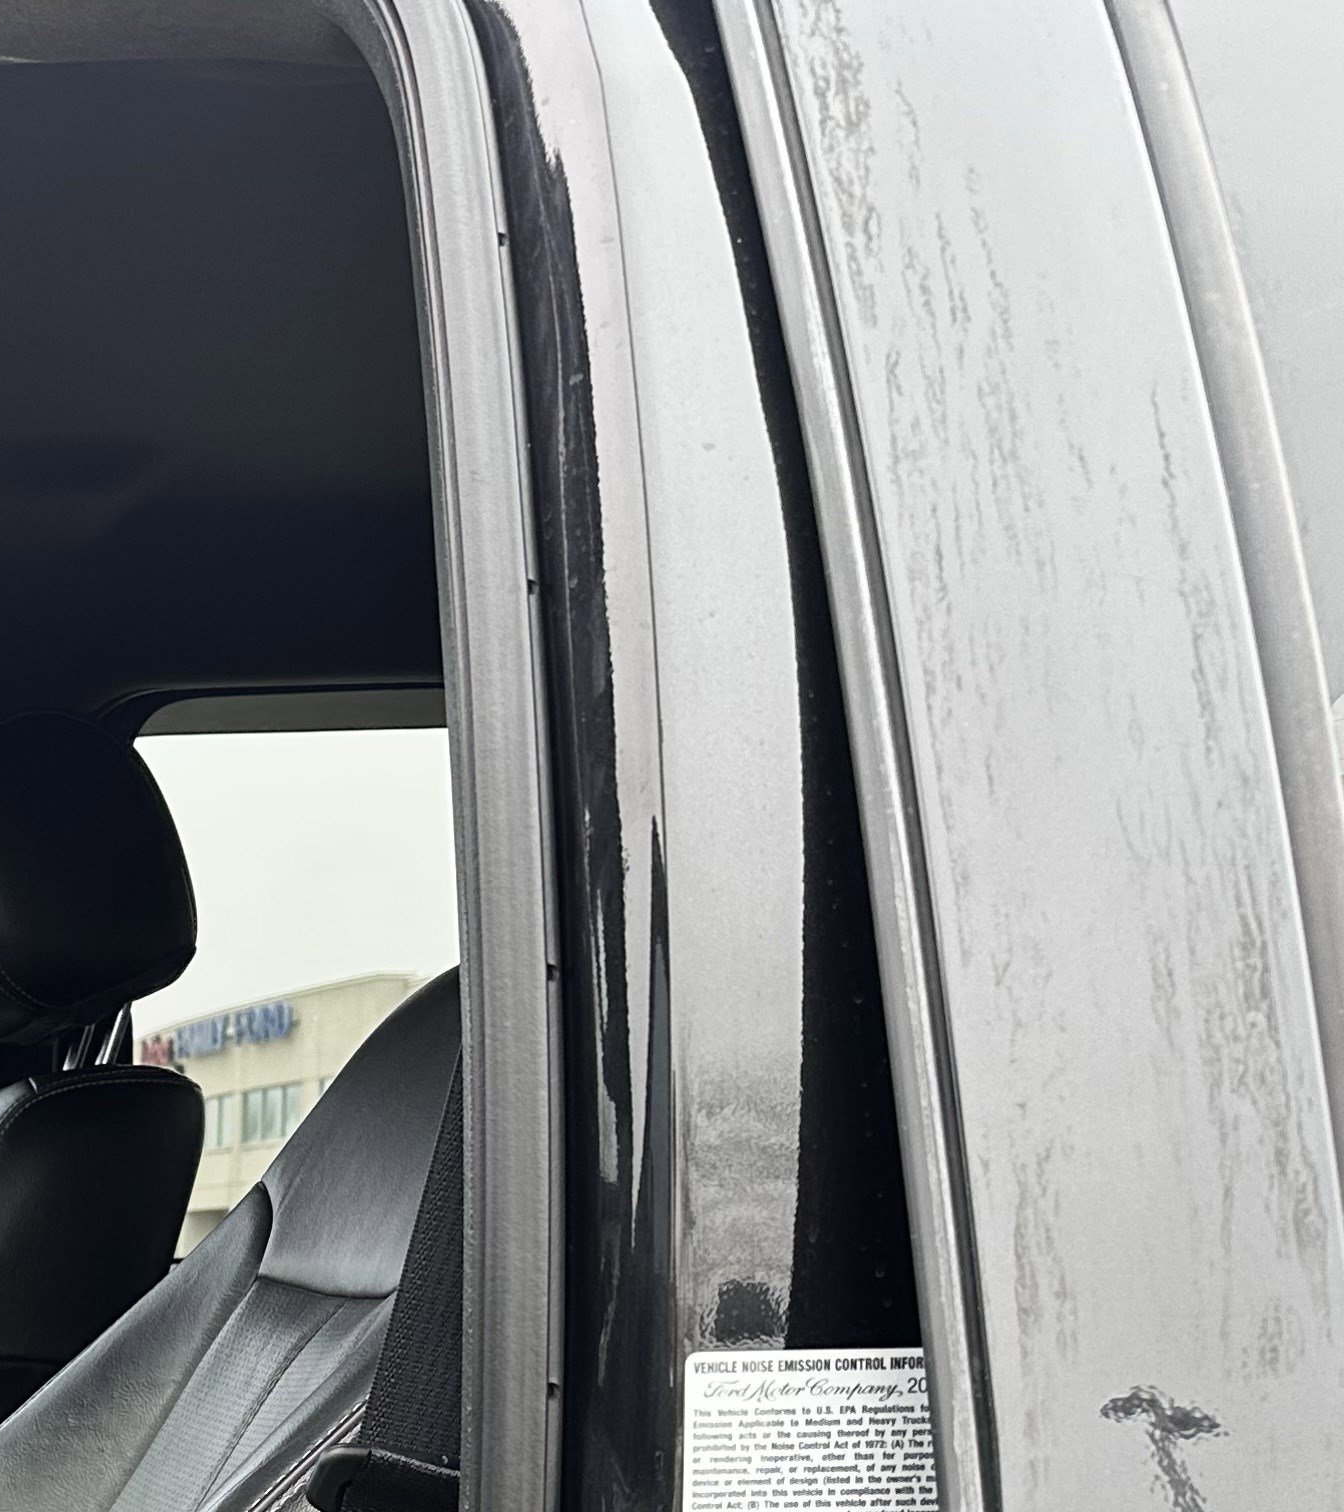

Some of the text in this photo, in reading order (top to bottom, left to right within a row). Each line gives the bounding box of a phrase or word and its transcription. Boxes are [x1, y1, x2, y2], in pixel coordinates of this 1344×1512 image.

[694, 1361, 737, 1374] VEHICLE
[742, 1360, 773, 1373] NOISE
[778, 1359, 831, 1372] EMISSION
[835, 1357, 887, 1371] CONTROL
[704, 1379, 749, 1398] Ford
[748, 1379, 806, 1402] Motor
[802, 1407, 811, 1415] to
[840, 1406, 856, 1414] EPA
[862, 1405, 914, 1415] Regulations
[805, 1418, 840, 1426] Medium
[847, 1417, 863, 1425] and
[869, 1417, 896, 1427] Heavy
[777, 1430, 791, 1439] the
[875, 1429, 885, 1438] by
[891, 1429, 907, 1438] any
[741, 1444, 750, 1452] by
[799, 1441, 830, 1450] Control
[834, 1440, 848, 1449] Act
[852, 1440, 861, 1449] of
[891, 1439, 904, 1450] (A)
[908, 1439, 924, 1448] The
[883, 1451, 896, 1460] for
[867, 1463, 875, 1472] of
[880, 1464, 896, 1473] any
[902, 1463, 925, 1471] noise
[776, 1477, 785, 1485] of
[868, 1475, 882, 1483] the
[895, 1486, 914, 1495] with
[919, 1486, 933, 1494] the
[692, 1501, 722, 1510] Control
[764, 1500, 780, 1508] The
[803, 1500, 811, 1508] of
[836, 1499, 866, 1507] vehicle
[870, 1498, 892, 1506] after
[895, 1498, 916, 1506] such
